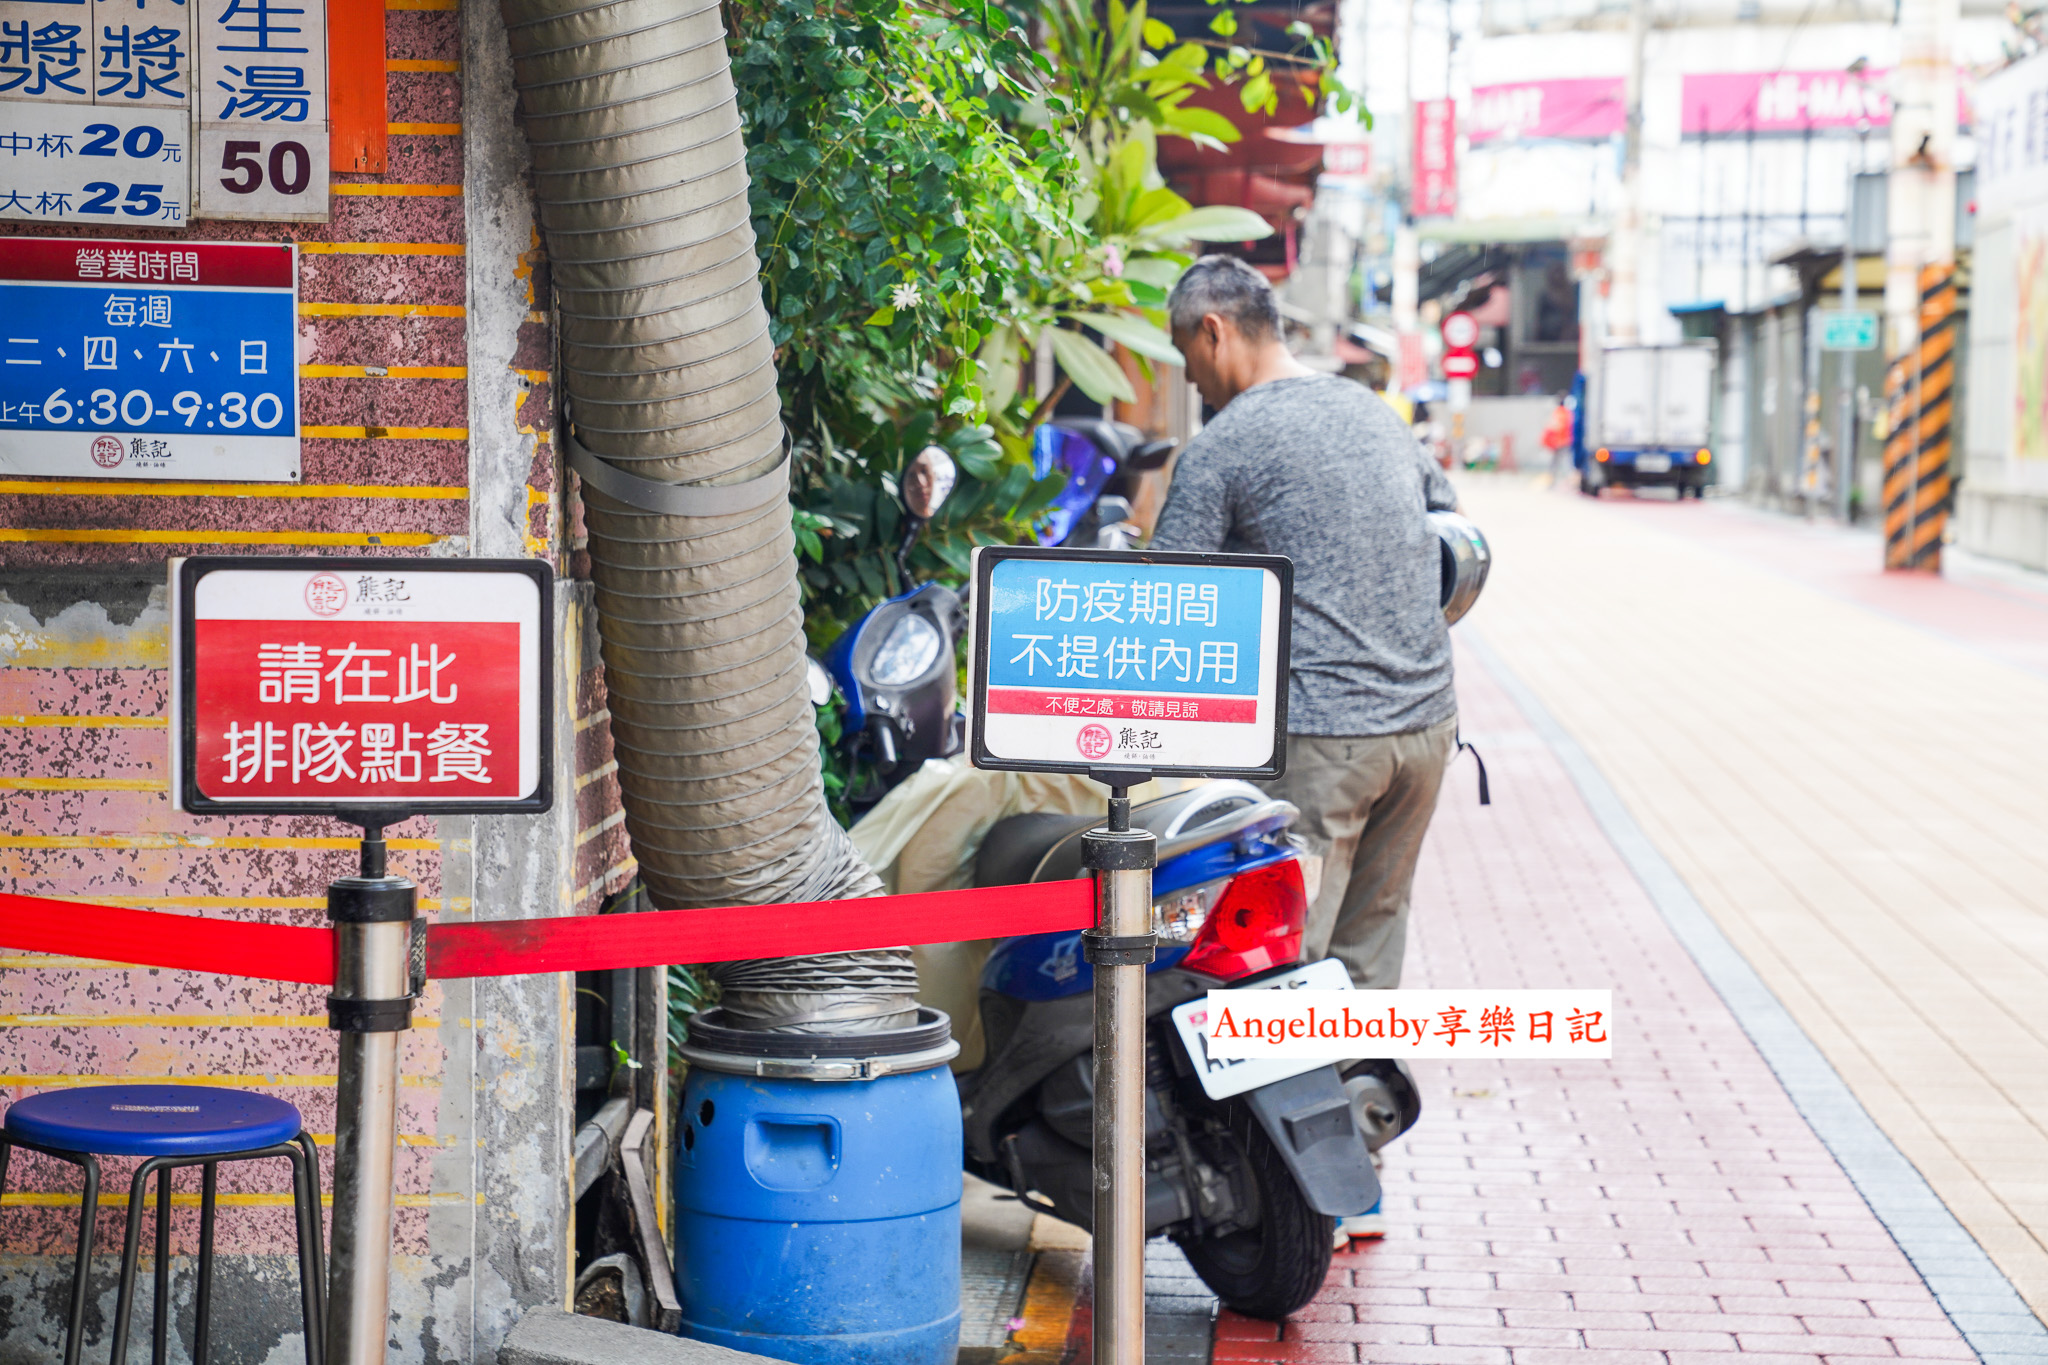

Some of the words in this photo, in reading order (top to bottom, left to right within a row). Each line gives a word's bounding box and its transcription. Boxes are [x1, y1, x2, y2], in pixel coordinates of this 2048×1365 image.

[0, 0, 86, 94] 漿
[97, 0, 186, 99] 漿
[219, 140, 311, 195] 50
[0, 181, 182, 221] 大杯25元
[76, 247, 199, 282] 營業時間
[104, 293, 172, 328] 每週
[5, 335, 269, 375] 二、四、六、日
[129, 437, 172, 459] 熊記
[356, 575, 411, 603] 熊記
[1035, 578, 1219, 628] 防疫期間
[257, 641, 458, 705] 請在此
[1009, 633, 1239, 684] 不提供內用
[1046, 696, 1200, 719] 不便之處，敬請見諒
[221, 720, 493, 785] 排隊點餐
[1117, 726, 1163, 750] 熊記
